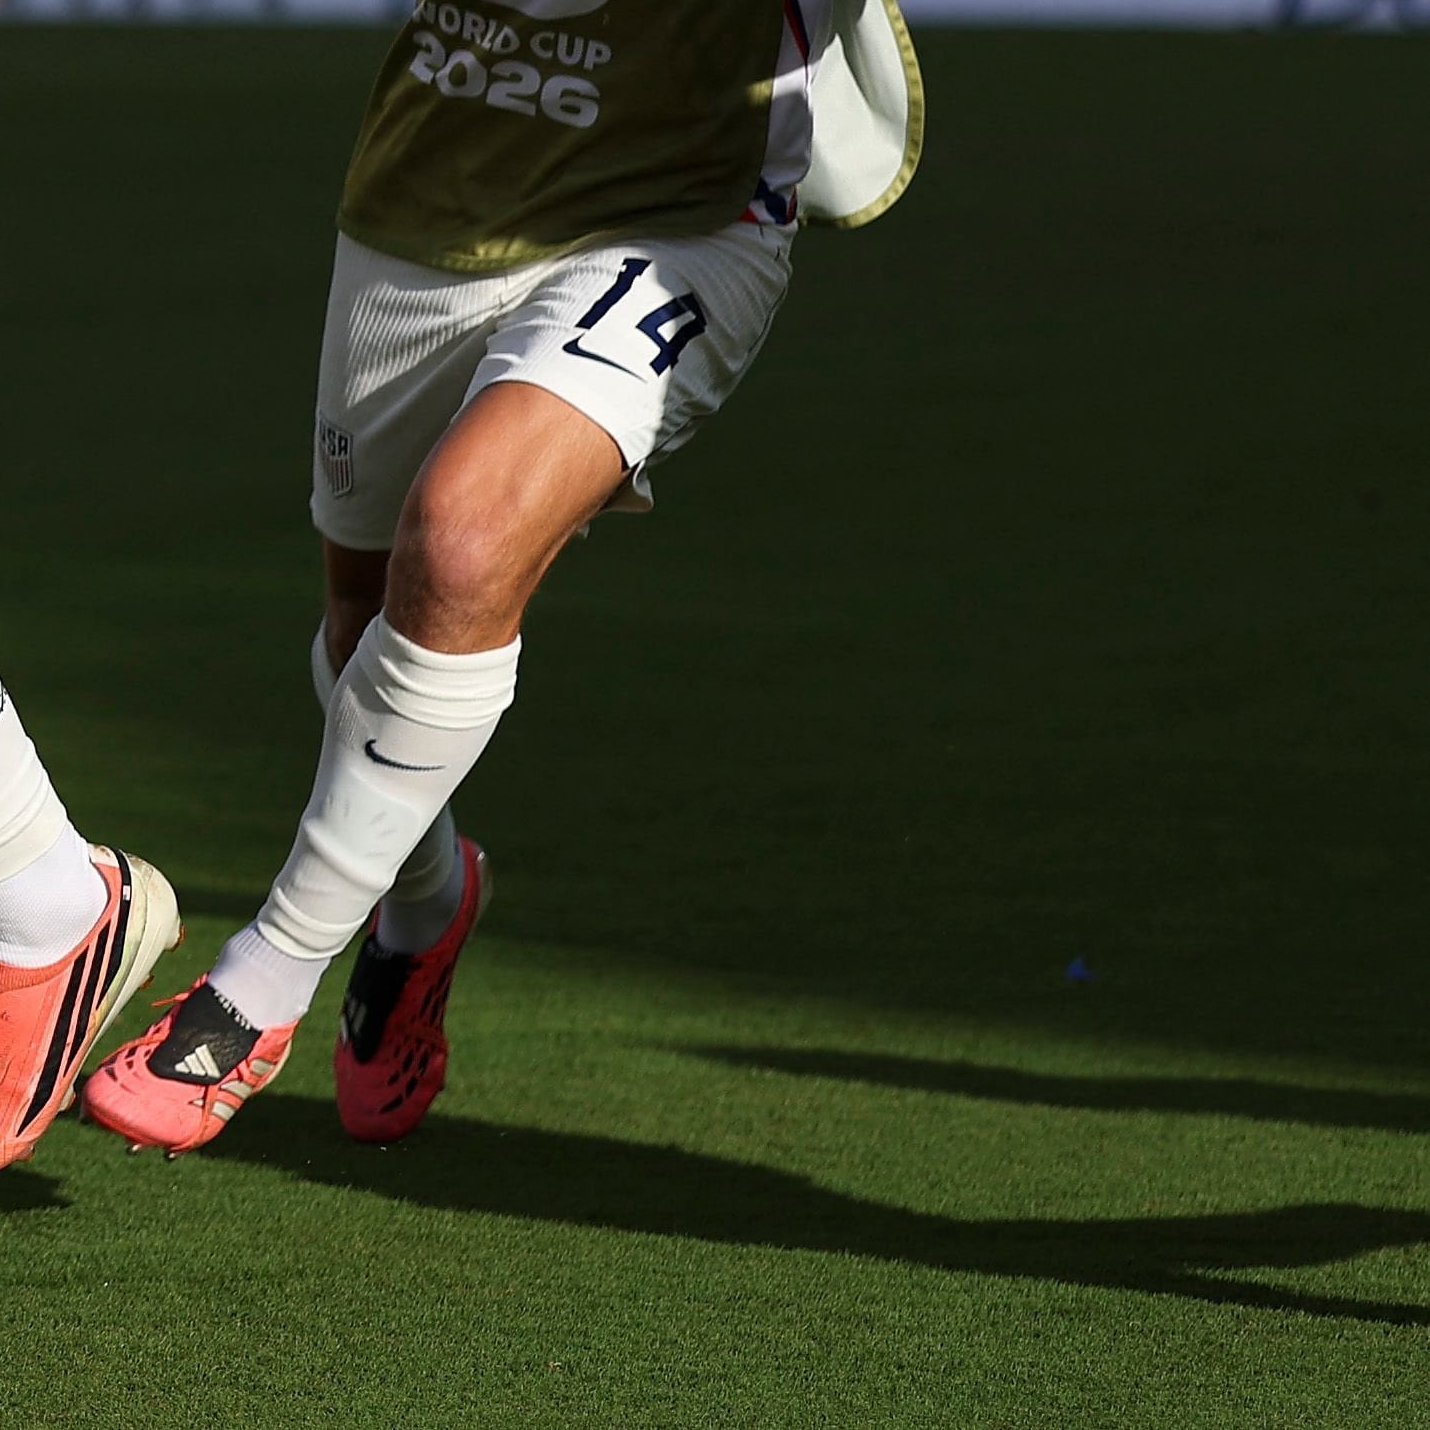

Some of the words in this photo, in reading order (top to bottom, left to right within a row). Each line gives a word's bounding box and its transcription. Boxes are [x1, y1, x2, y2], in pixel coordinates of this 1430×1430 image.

[408, 30, 601, 129] 2026
[529, 31, 612, 72] CUP
[575, 258, 708, 377] 14
